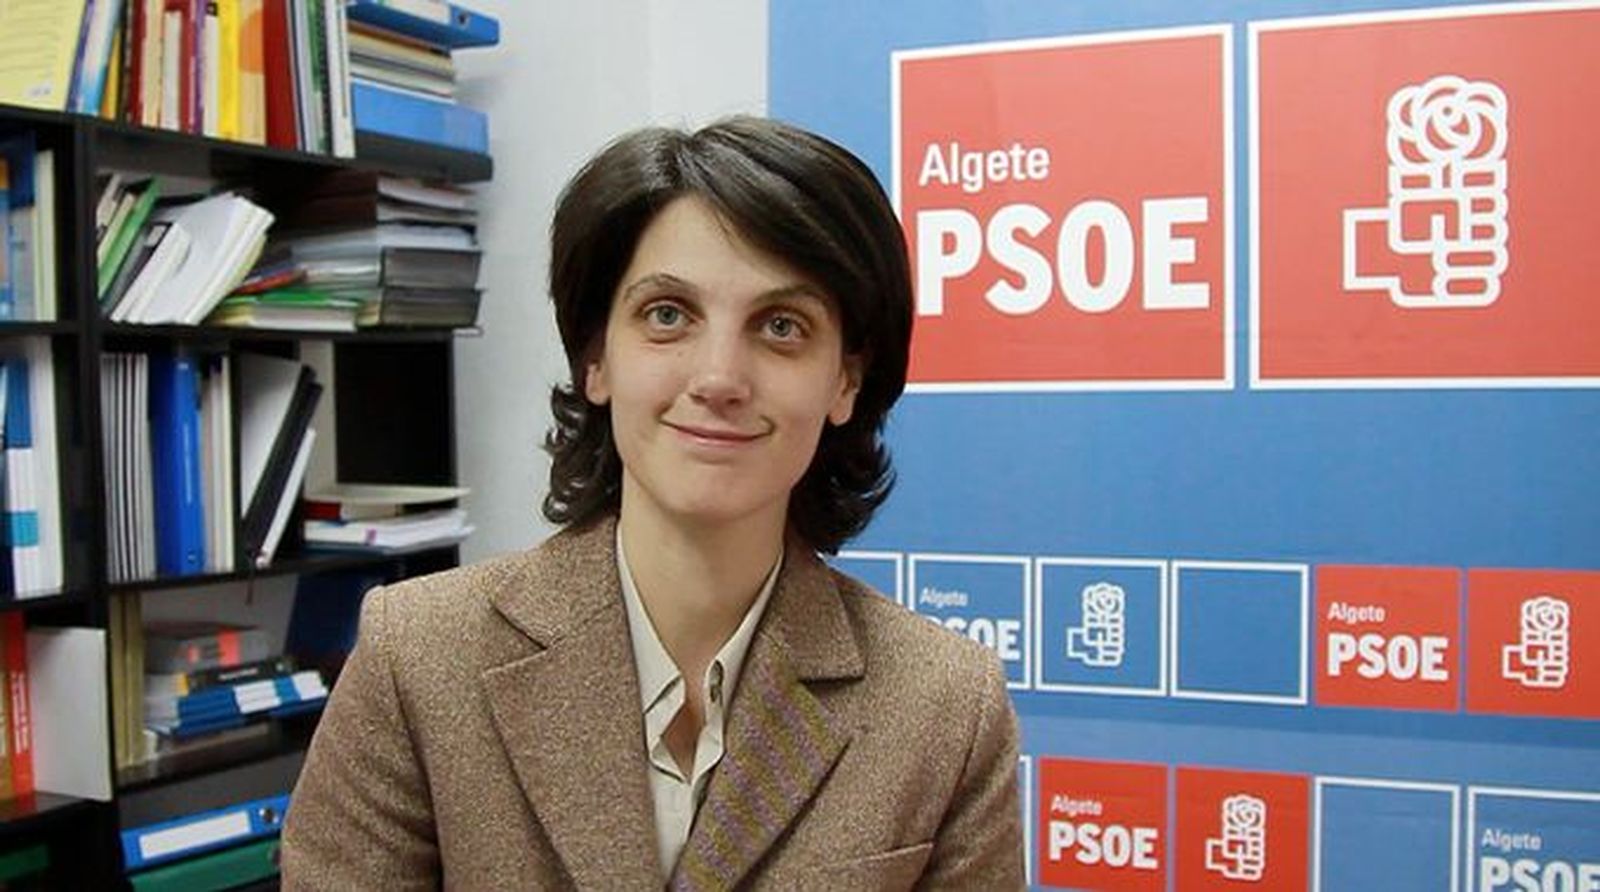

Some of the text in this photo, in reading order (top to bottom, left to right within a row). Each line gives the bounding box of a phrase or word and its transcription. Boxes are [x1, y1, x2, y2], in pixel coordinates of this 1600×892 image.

[919, 142, 1050, 193] Algete
[917, 197, 1211, 317] PSOE
[1327, 601, 1386, 624] Algete
[922, 616, 1021, 660] OE
[1327, 633, 1449, 680] PSOE
[1049, 820, 1158, 869] PSOE
[1481, 828, 1542, 853] Algete
